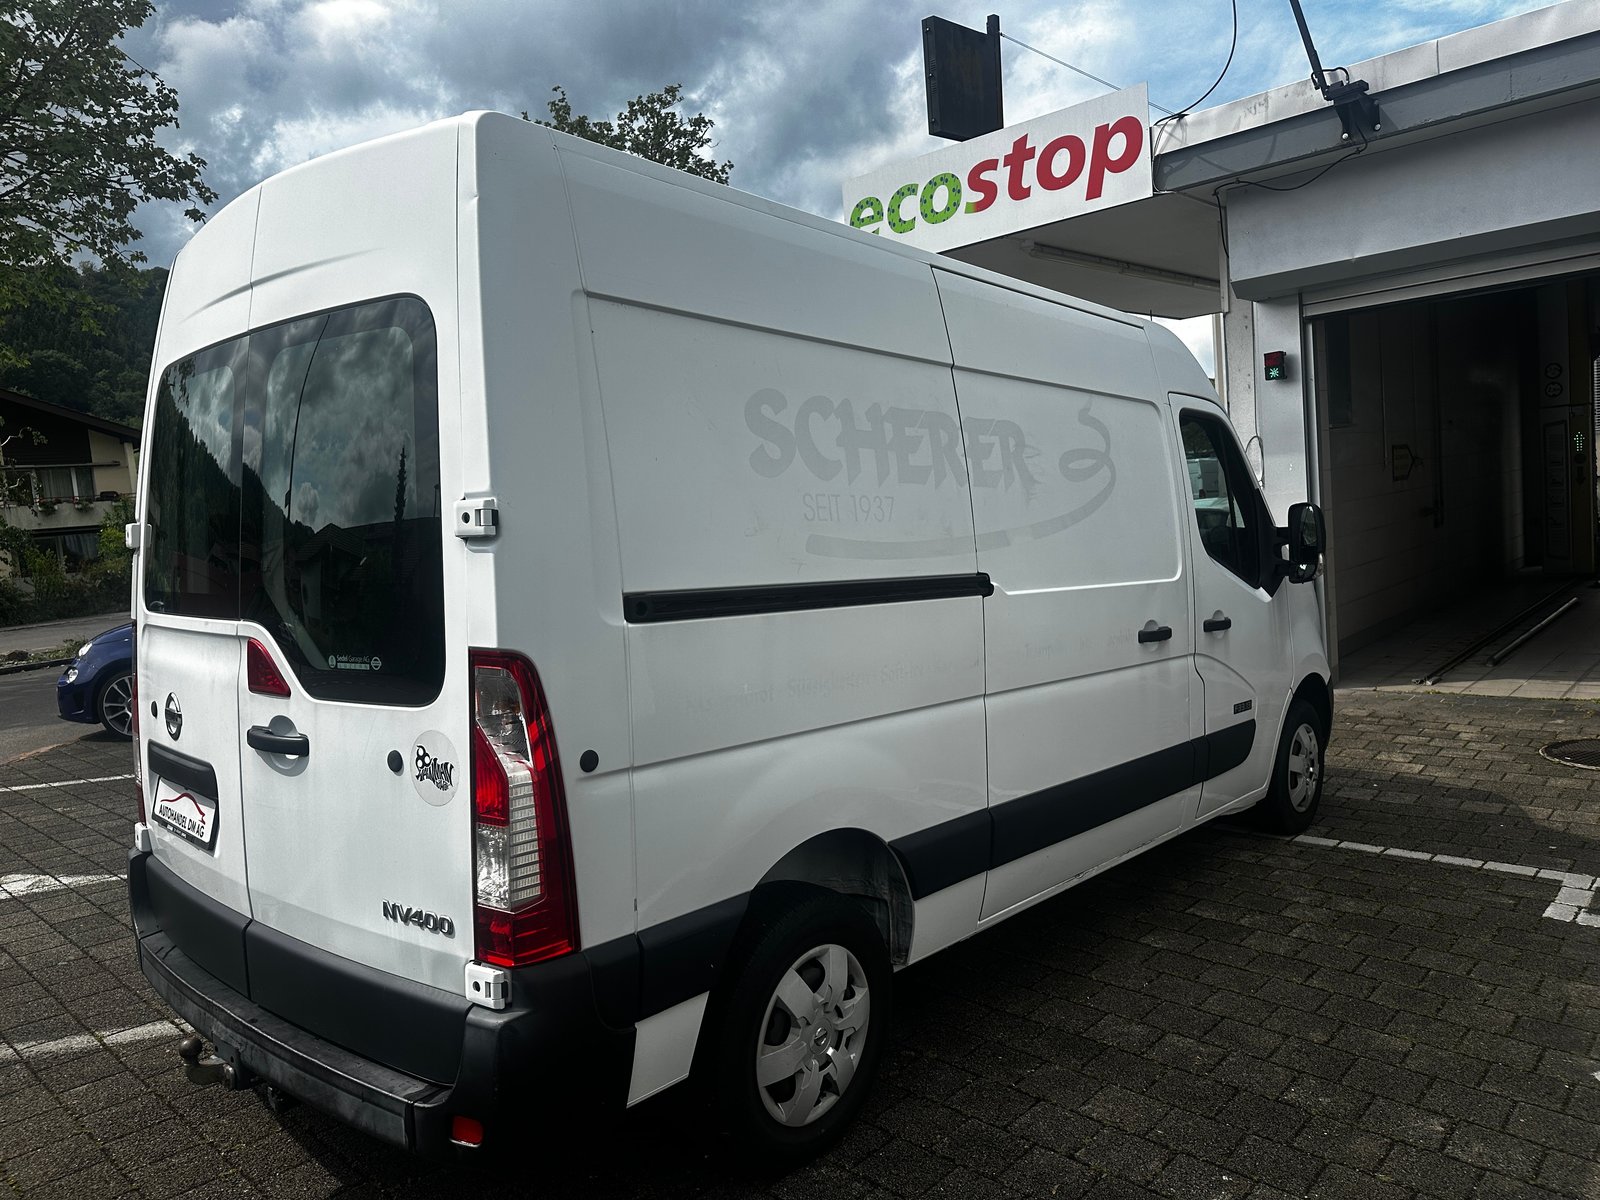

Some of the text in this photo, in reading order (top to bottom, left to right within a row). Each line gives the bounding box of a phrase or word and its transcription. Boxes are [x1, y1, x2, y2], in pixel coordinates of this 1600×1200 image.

[850, 115, 1144, 234] ecostop
[744, 387, 1038, 502] SCHERER
[802, 493, 896, 524] SEIT 1937
[159, 804, 187, 828] AUTOHANDEL
[188, 818, 197, 833] DM
[197, 824, 204, 837] AG
[382, 899, 455, 936] NV400
